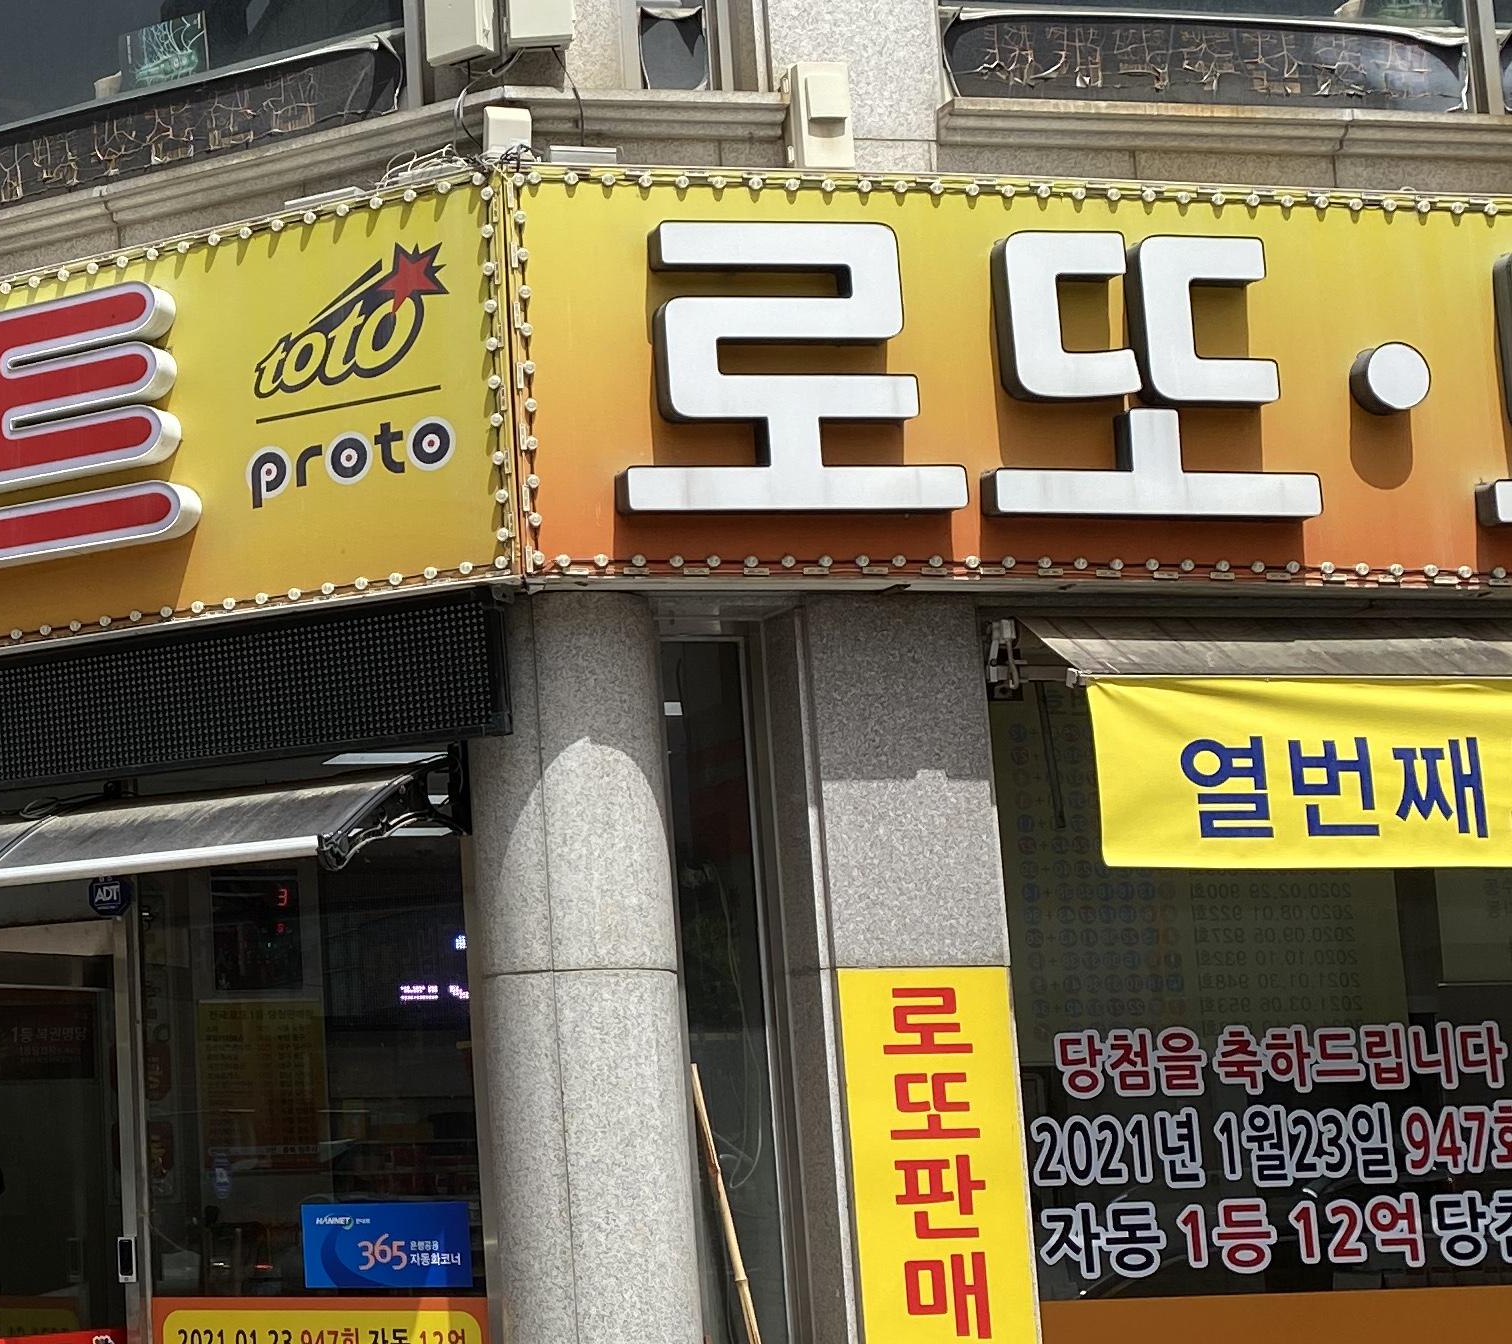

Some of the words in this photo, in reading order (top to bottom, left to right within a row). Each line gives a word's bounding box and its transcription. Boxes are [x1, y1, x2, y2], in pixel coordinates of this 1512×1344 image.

[245, 416, 456, 510] proto
[1179, 734, 1491, 840] 열번째
[94, 885, 120, 902] ADT
[1053, 1024, 1207, 1098] 당첨을
[1213, 1021, 1509, 1096] 축하드립니다
[1031, 1106, 1207, 1189] 2021년
[357, 1232, 409, 1271] 365
[409, 1252, 462, 1267] 자동화코너
[1040, 1199, 1168, 1279] 자동
[1176, 1196, 1278, 1274] 1등
[1288, 1191, 1426, 1268] 12억
